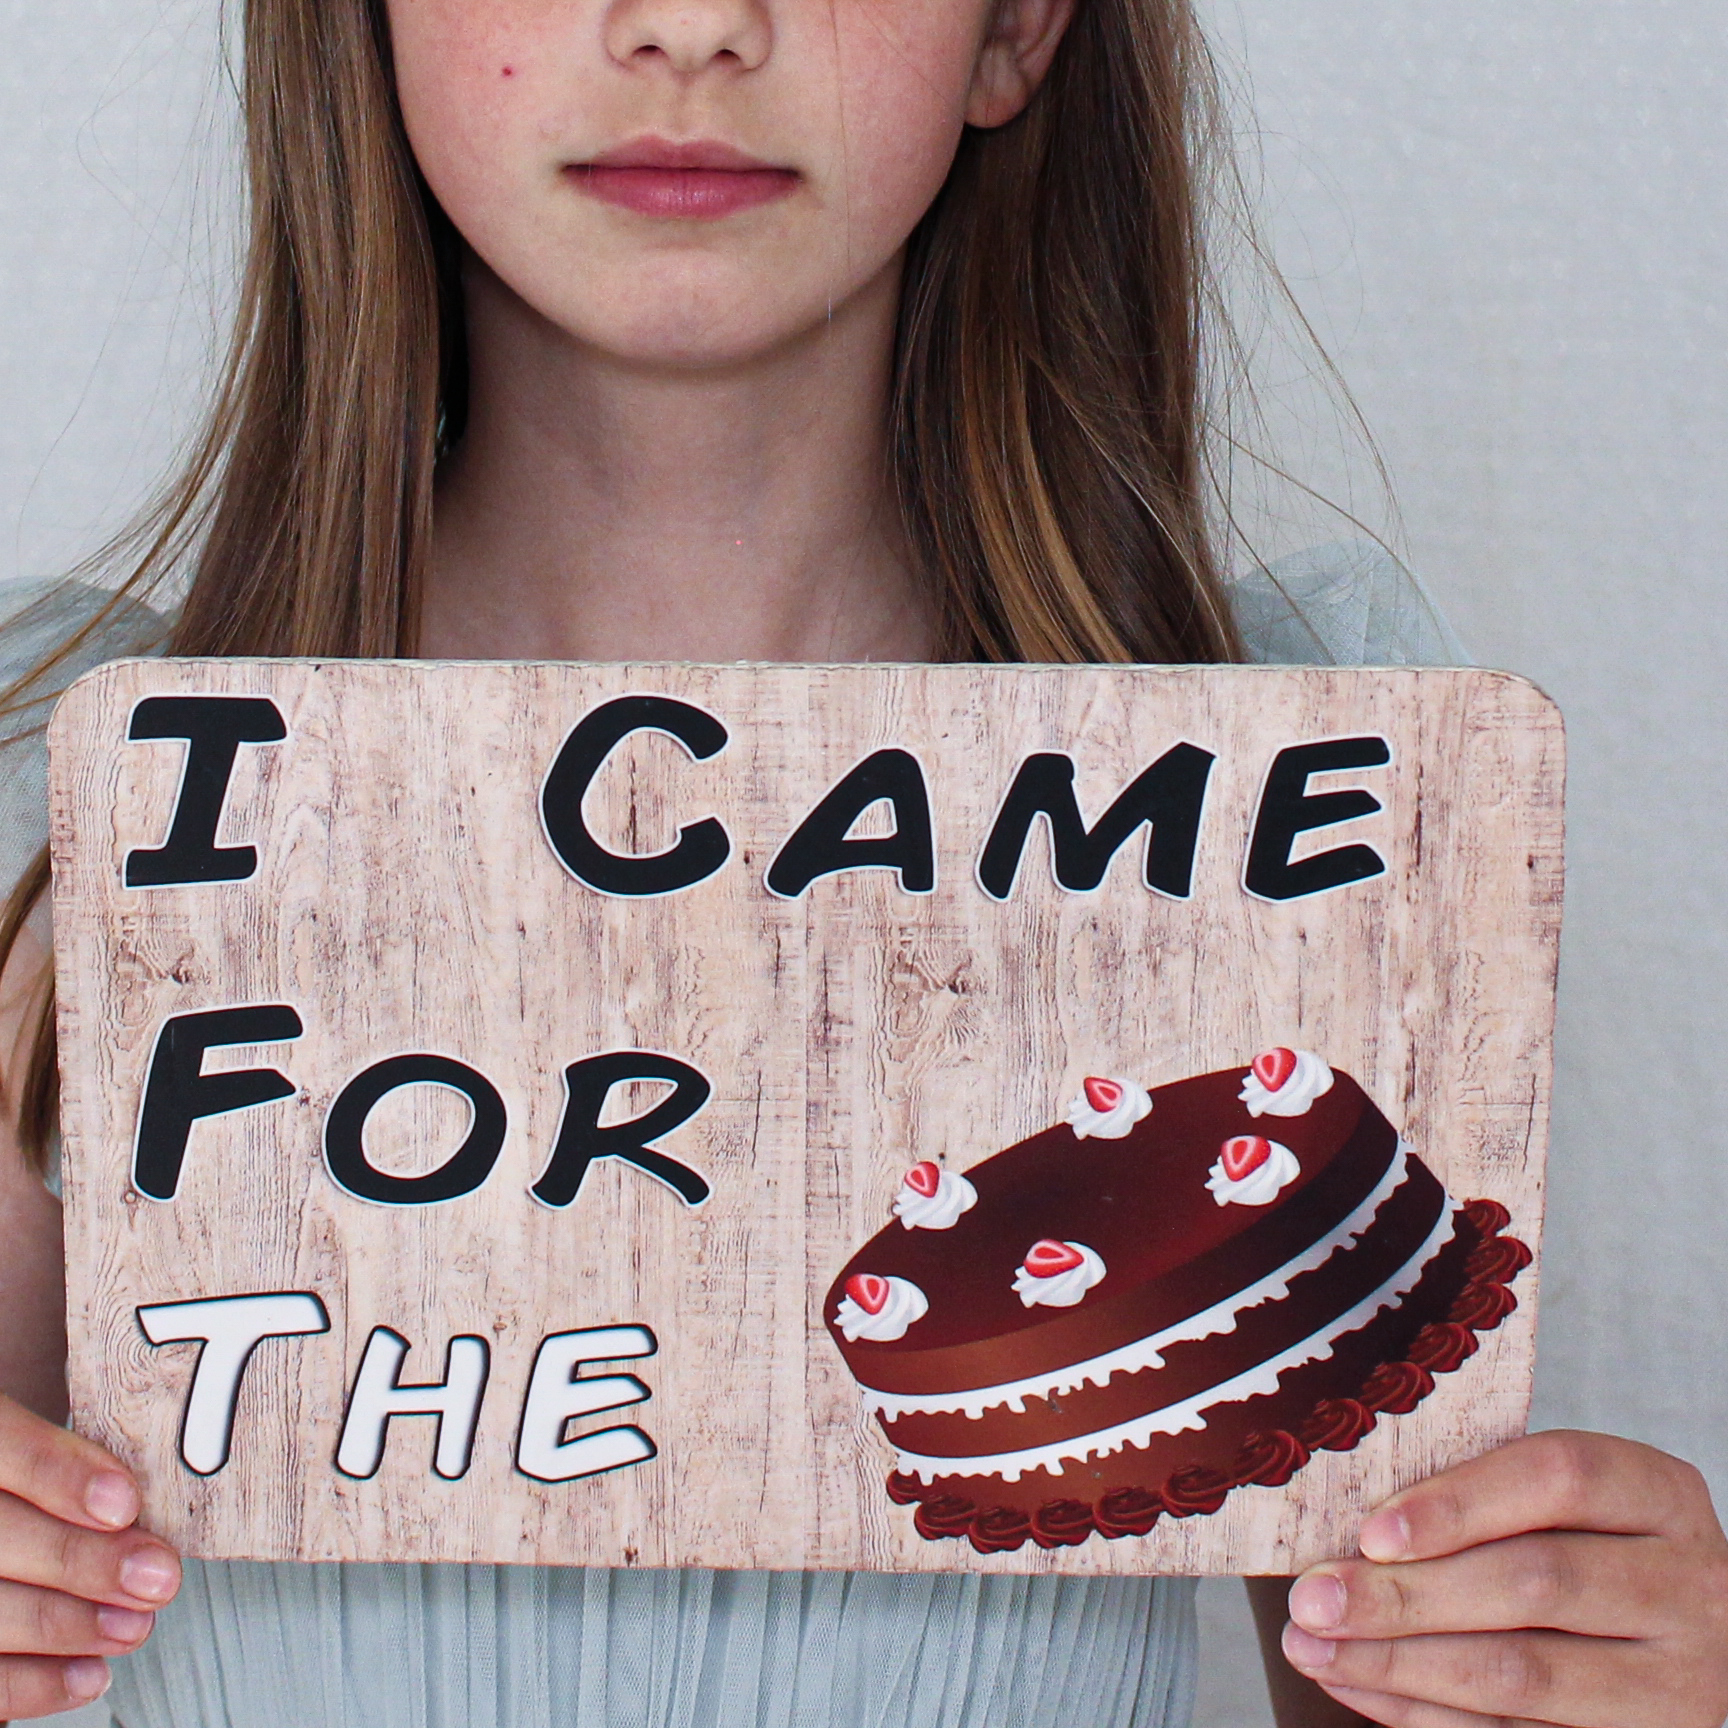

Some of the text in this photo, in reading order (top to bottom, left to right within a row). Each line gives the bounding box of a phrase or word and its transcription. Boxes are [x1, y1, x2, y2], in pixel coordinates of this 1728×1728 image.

[122, 693, 1393, 903] I CAME
[131, 1002, 714, 1210] FOR
[134, 1288, 661, 1486] THE
